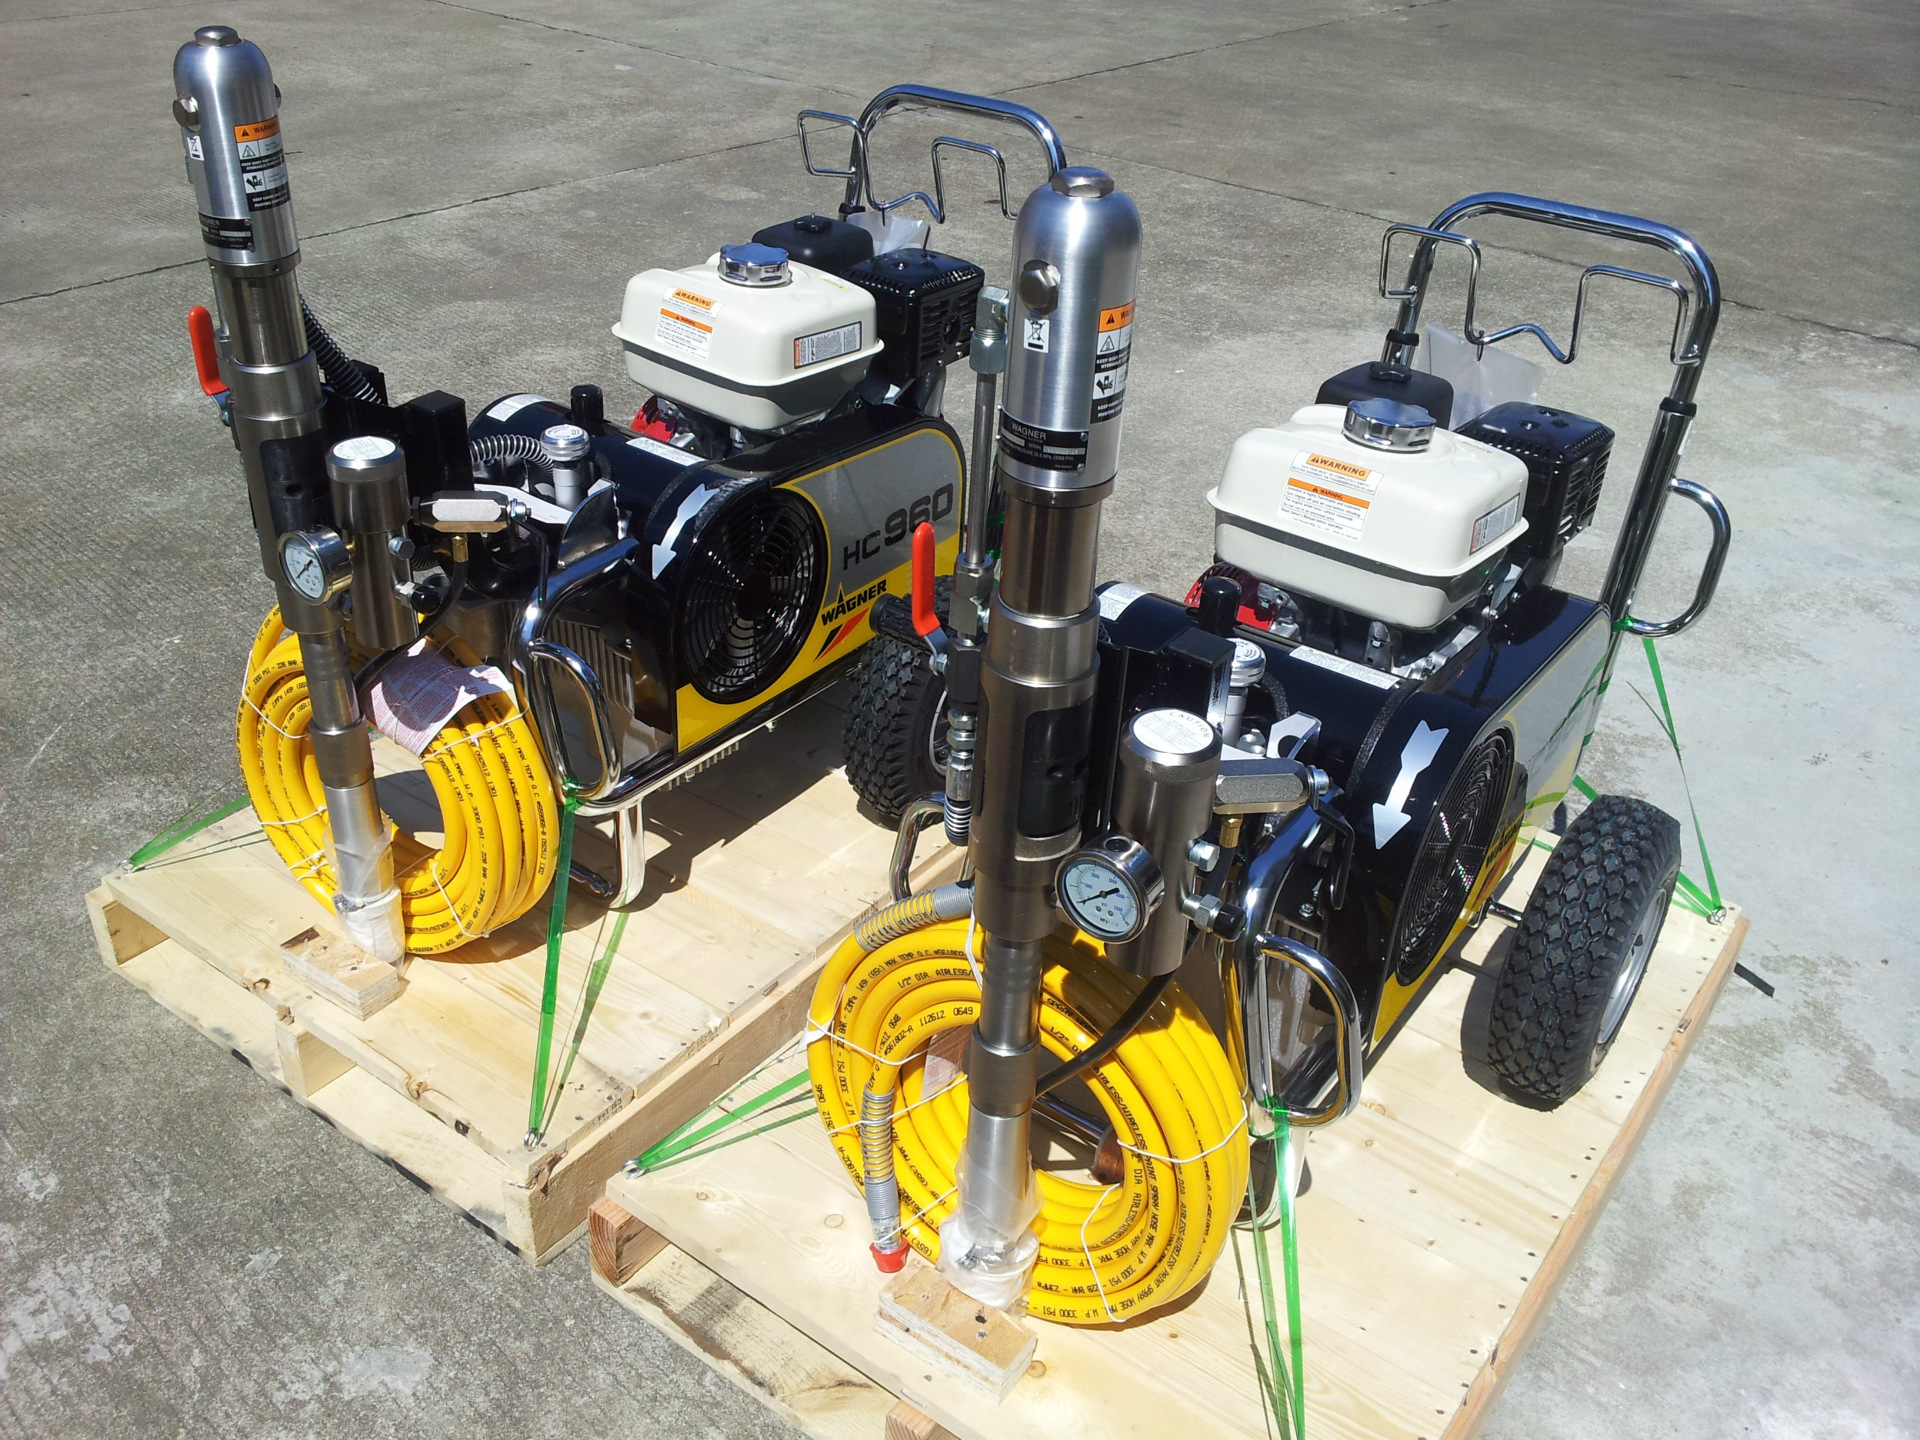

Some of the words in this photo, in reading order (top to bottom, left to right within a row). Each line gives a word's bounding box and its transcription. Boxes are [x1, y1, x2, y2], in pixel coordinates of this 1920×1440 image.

[680, 292, 711, 306] WARNING
[1012, 423, 1046, 440] WAGNER
[1319, 458, 1366, 477] WARNING
[1319, 488, 1343, 500] WARNING
[821, 580, 887, 626] WAGNER
[1170, 712, 1210, 738] CAUTION
[516, 747, 526, 760] MAX
[524, 764, 534, 782] TEMP
[898, 952, 914, 961] TEMP
[898, 976, 911, 988] 1/2"
[920, 1010, 946, 1027] 112612
[953, 1006, 973, 1016] 0649
[838, 1021, 847, 1035] BAR
[1050, 1026, 1070, 1042] 1/2"
[836, 1060, 845, 1074] PSI
[838, 1075, 849, 1094] 3300
[822, 1110, 838, 1138] 12612
[837, 1145, 864, 1187] #561802-A
[1150, 1184, 1159, 1211] SPRAY
[1149, 1212, 1159, 1232] HOSE
[1115, 1244, 1131, 1258] HOSE
[1052, 1258, 1071, 1266] 3300
[1121, 1264, 1136, 1280] 3300
[1155, 1268, 1170, 1288] PAINT
[1108, 1276, 1120, 1287] PSI
[1072, 1286, 1085, 1294] BAR
[1137, 1284, 1154, 1303] SPRAY
[1043, 1306, 1056, 1316] PSI
[1120, 1296, 1136, 1311] HOSE
[1060, 1308, 1078, 1318] 3300
